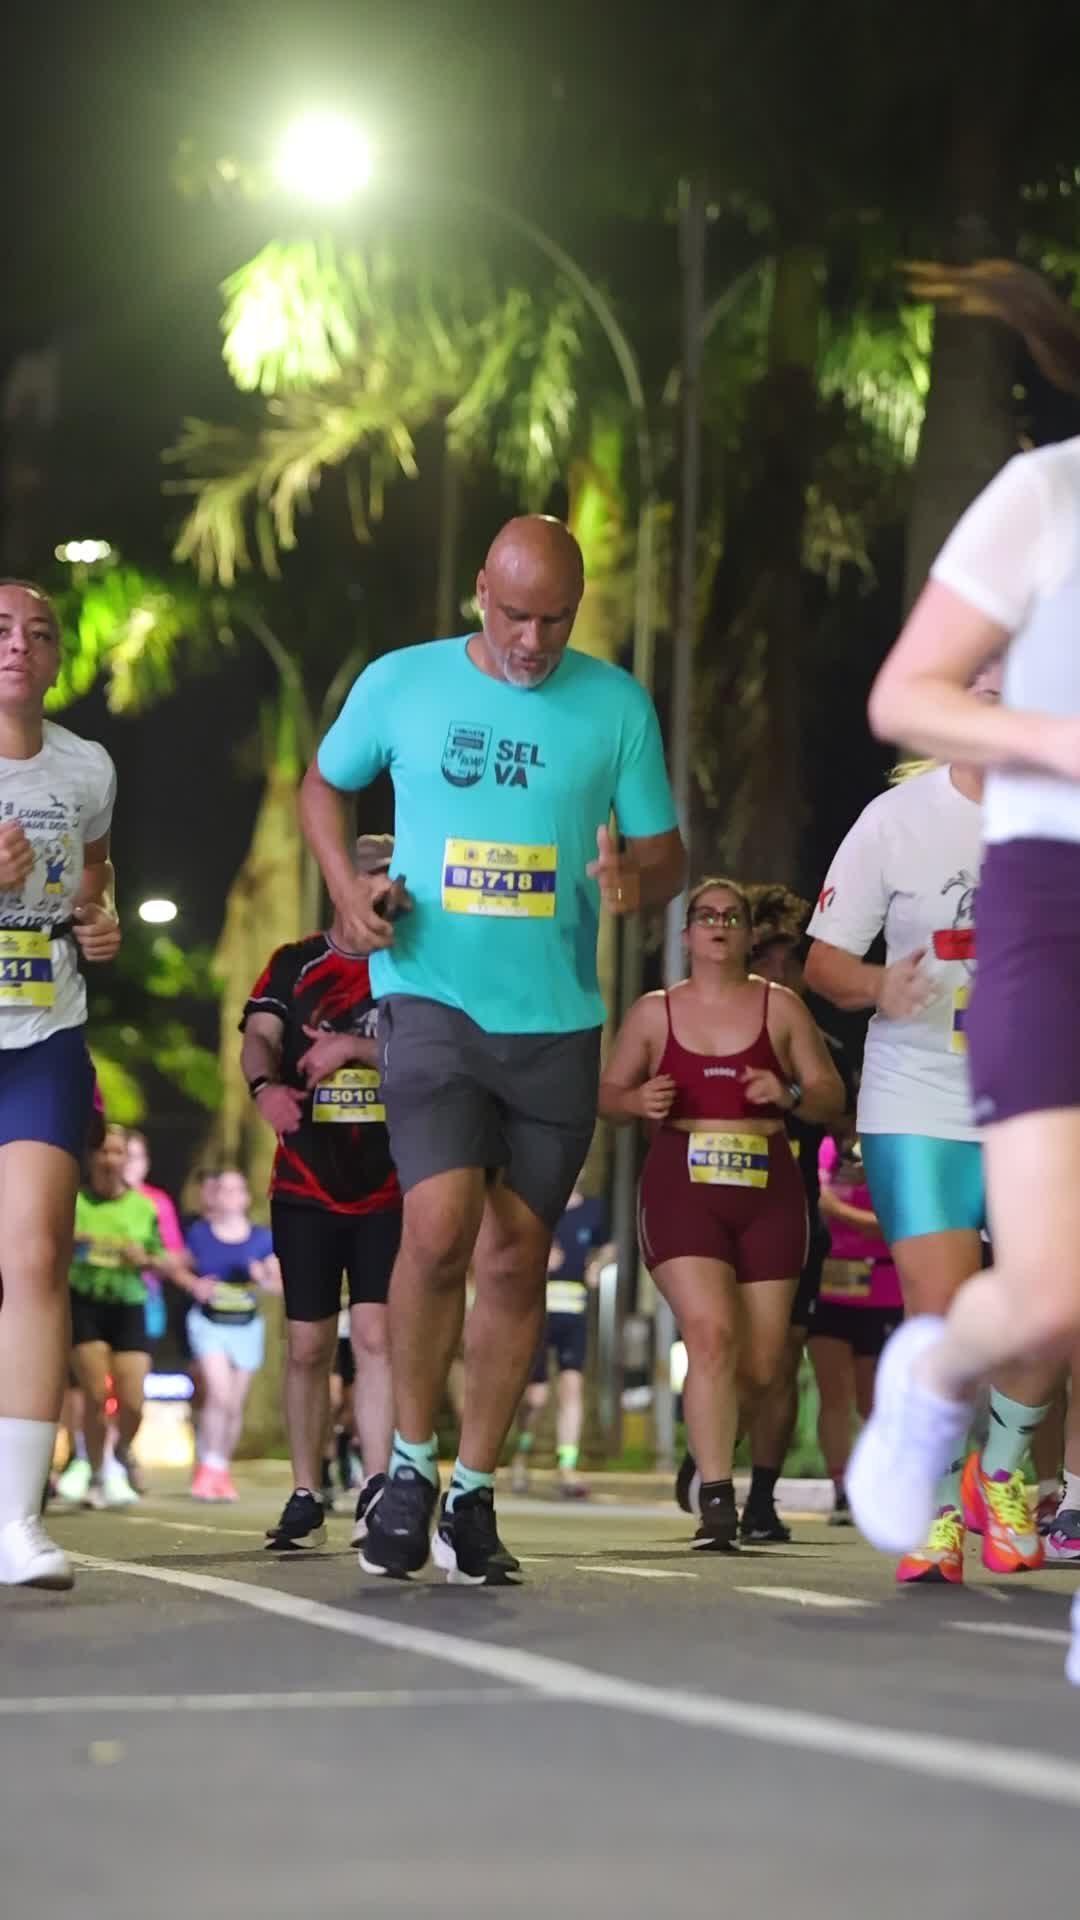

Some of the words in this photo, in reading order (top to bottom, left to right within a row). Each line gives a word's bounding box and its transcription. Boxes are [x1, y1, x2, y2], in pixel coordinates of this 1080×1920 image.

[496, 739, 546, 768] SEL
[495, 763, 528, 789] VA
[469, 868, 532, 891] 5718
[330, 1089, 376, 1102] 5010
[707, 1153, 752, 1168] 6121
